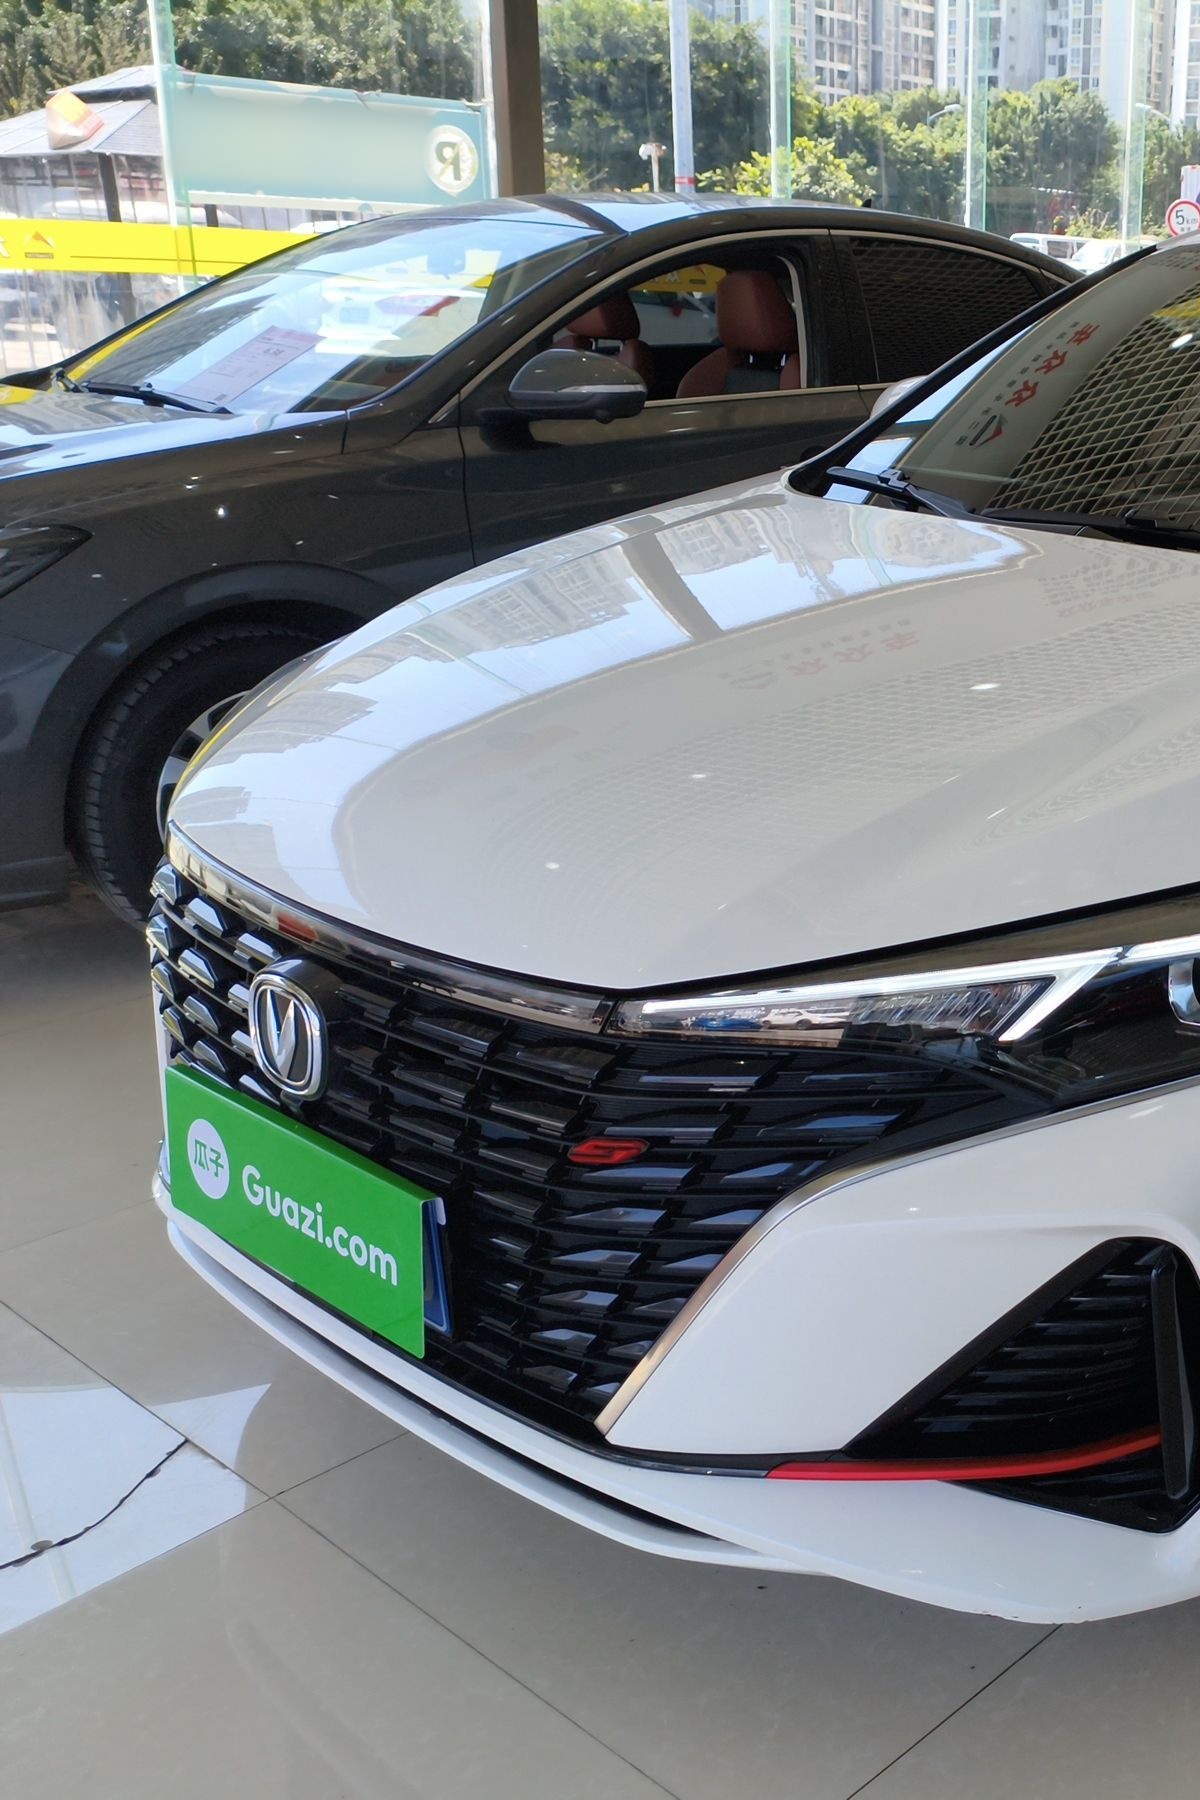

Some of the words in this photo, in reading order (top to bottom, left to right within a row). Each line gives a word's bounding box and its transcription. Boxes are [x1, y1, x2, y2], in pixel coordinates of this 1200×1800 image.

[1175, 209, 1185, 225] 5
[194, 1139, 224, 1177] 瓜子
[242, 1164, 398, 1287] Guazi.com
